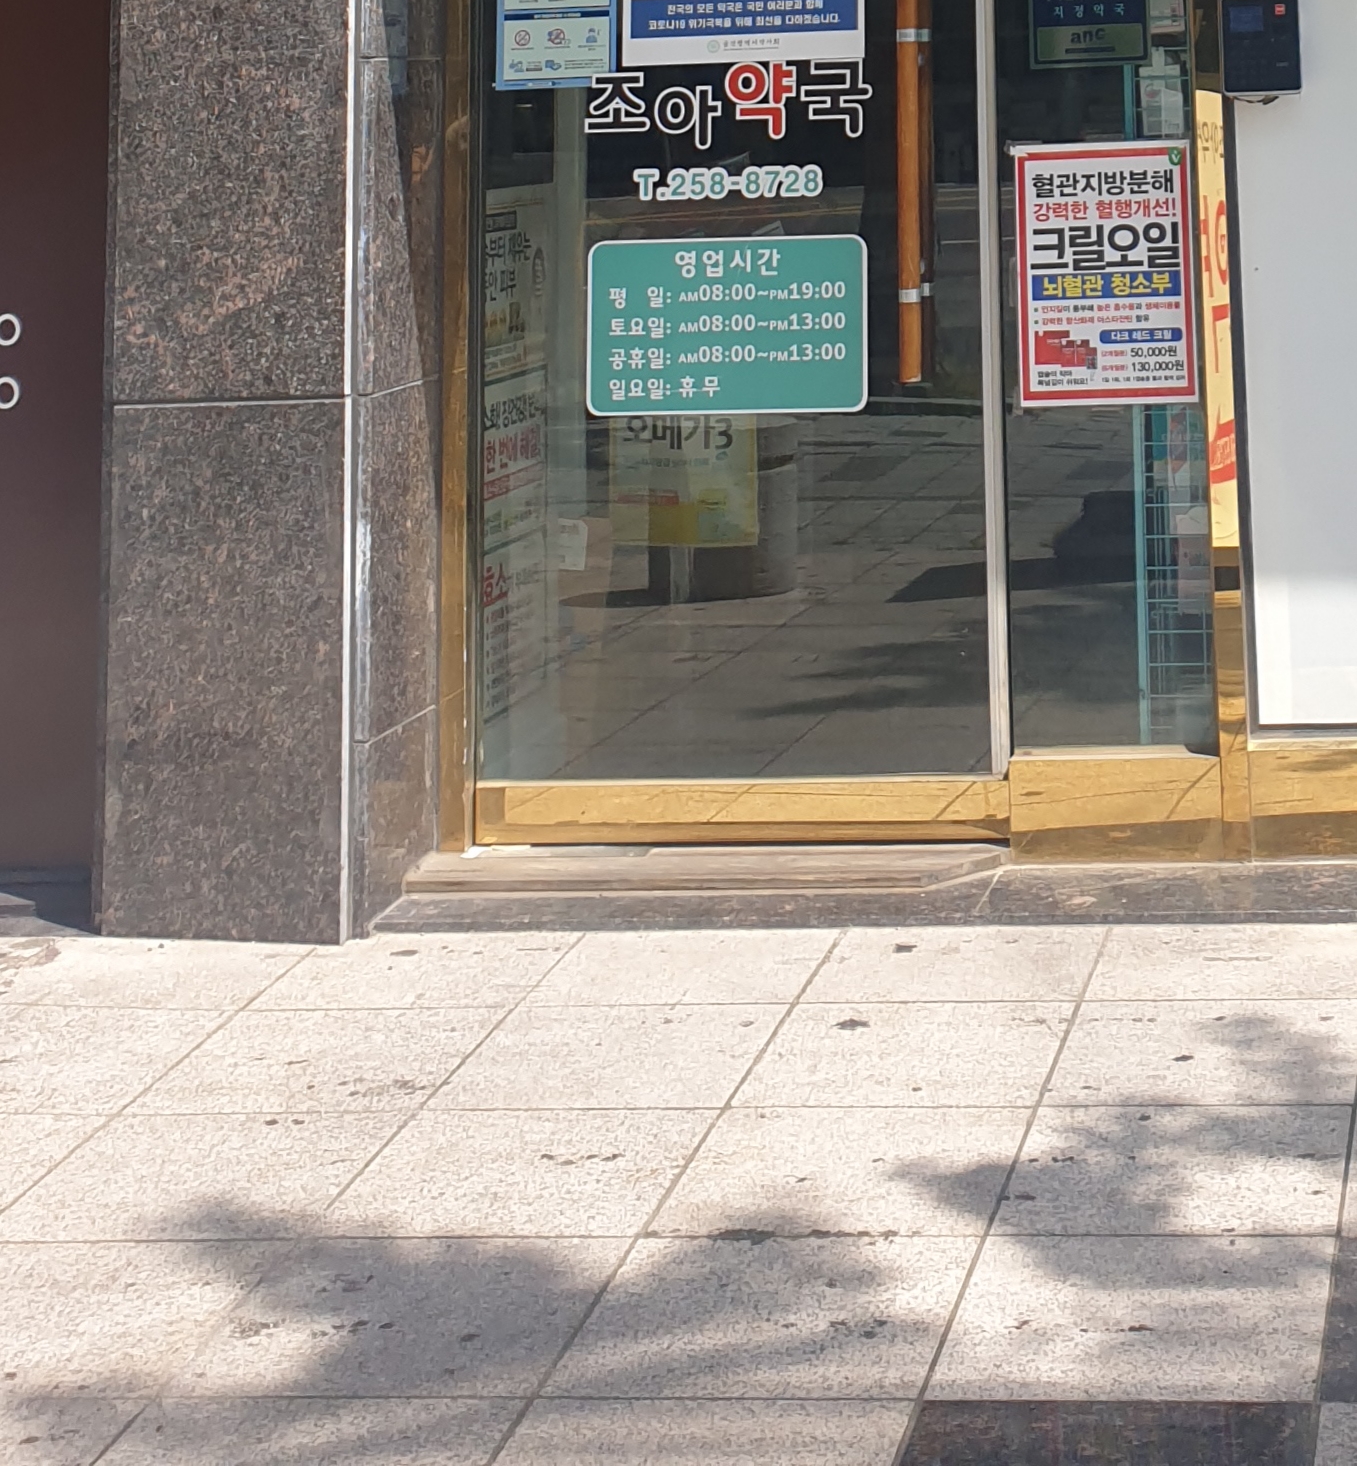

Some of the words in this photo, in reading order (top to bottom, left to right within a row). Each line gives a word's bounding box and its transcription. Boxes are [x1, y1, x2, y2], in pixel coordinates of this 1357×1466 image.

[667, 3, 694, 15] 전국의
[697, 3, 715, 14] 모든
[717, 1, 744, 13] 약국은
[746, 0, 764, 12] 국민
[767, 0, 803, 11] 여러분과
[1053, 2, 1126, 19] 지정약국
[649, 20, 686, 31] 코로나19
[688, 17, 733, 30] 위기극복을
[735, 16, 754, 28] 위해
[756, 15, 783, 27] 최선을
[1070, 27, 1106, 45] anc
[584, 57, 873, 150] 조아약국
[633, 164, 824, 201] T.258-8728
[1032, 168, 1175, 199] 혈관지방분해
[1033, 201, 1089, 222] 강력한
[1095, 198, 1177, 220] 혈행개선!
[1030, 221, 1181, 272] 크릴오일
[675, 248, 781, 279] 영업시간
[1043, 275, 1104, 297] 뇌혈관
[1111, 271, 1173, 295] 청소부
[1111, 331, 1130, 341] 다크
[1153, 329, 1173, 340] 크릴
[1130, 345, 1178, 358] 50,000원
[1131, 360, 1185, 373] 130,000원
[622, 415, 734, 451] 오메가3
